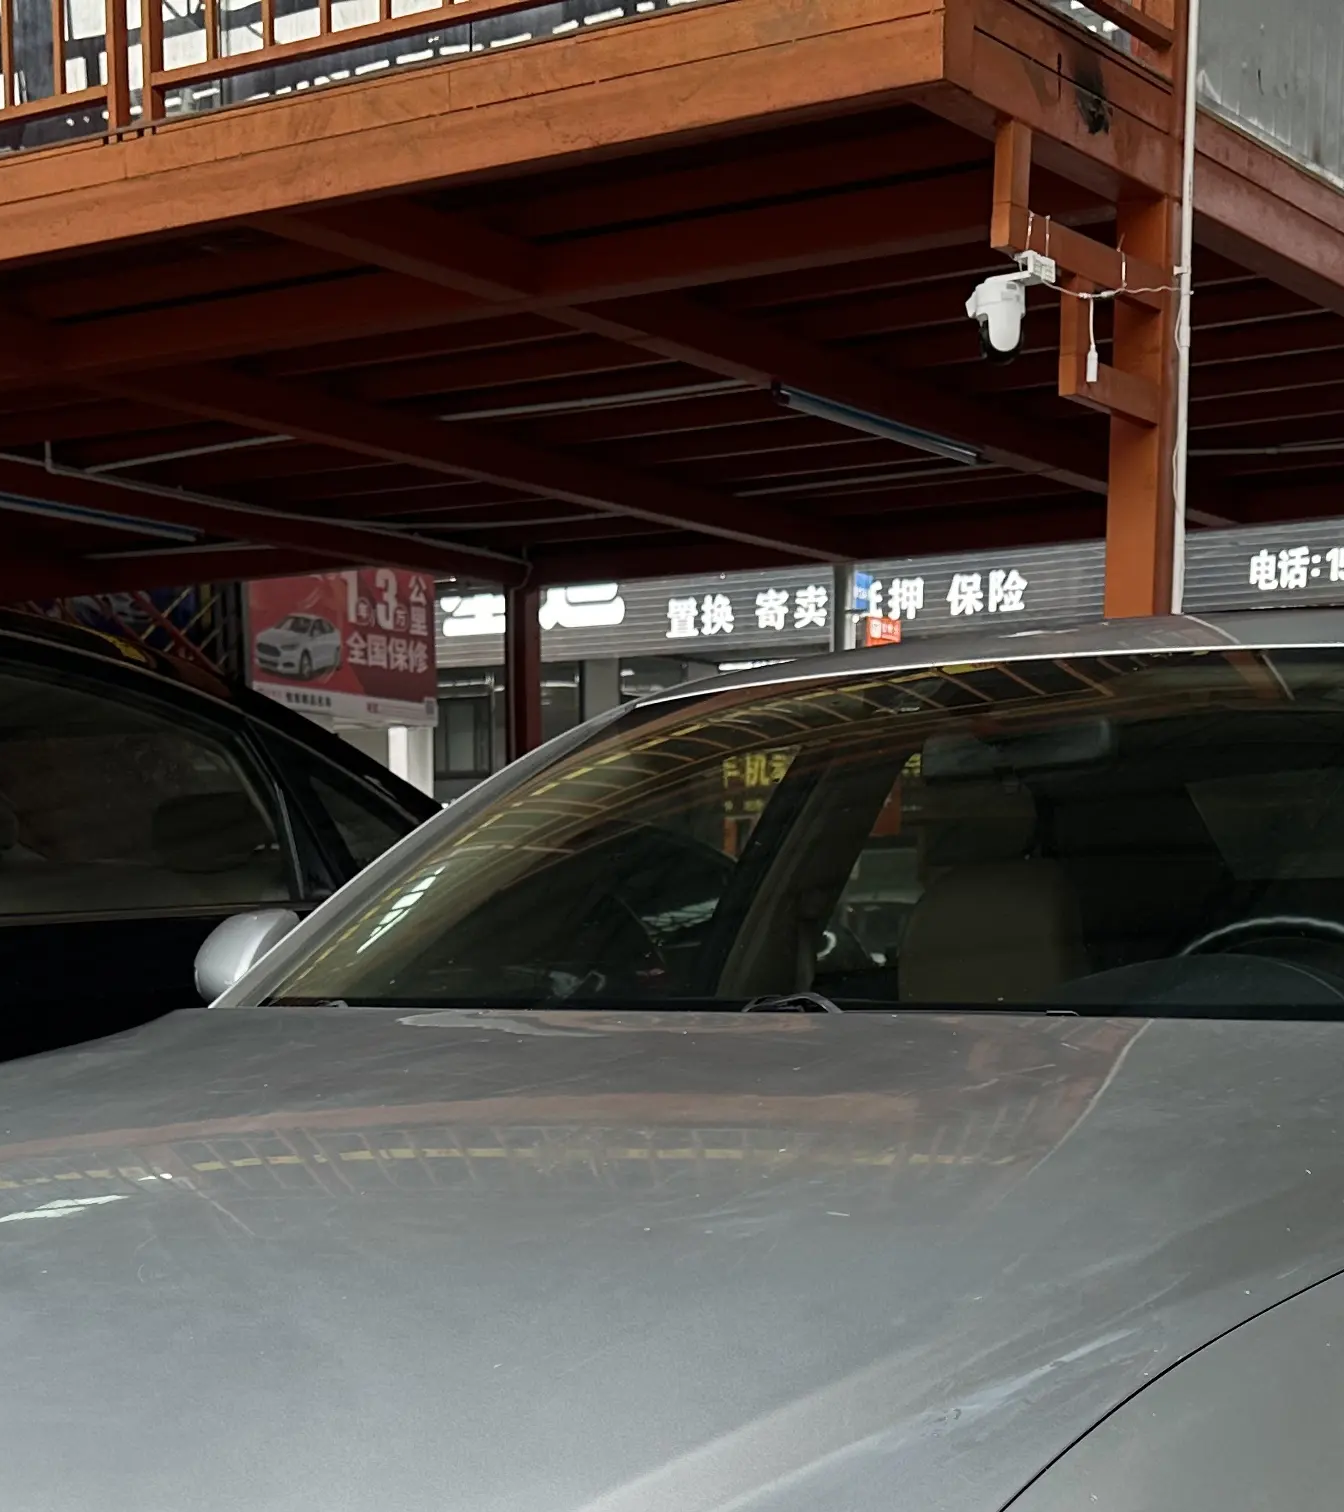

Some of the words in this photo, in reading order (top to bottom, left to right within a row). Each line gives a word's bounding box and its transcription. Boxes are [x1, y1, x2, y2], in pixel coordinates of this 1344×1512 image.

[665, 593, 735, 638] 置换
[755, 584, 828, 630] 寄卖
[946, 569, 1028, 616] 保险
[346, 631, 428, 674] 全国保修
